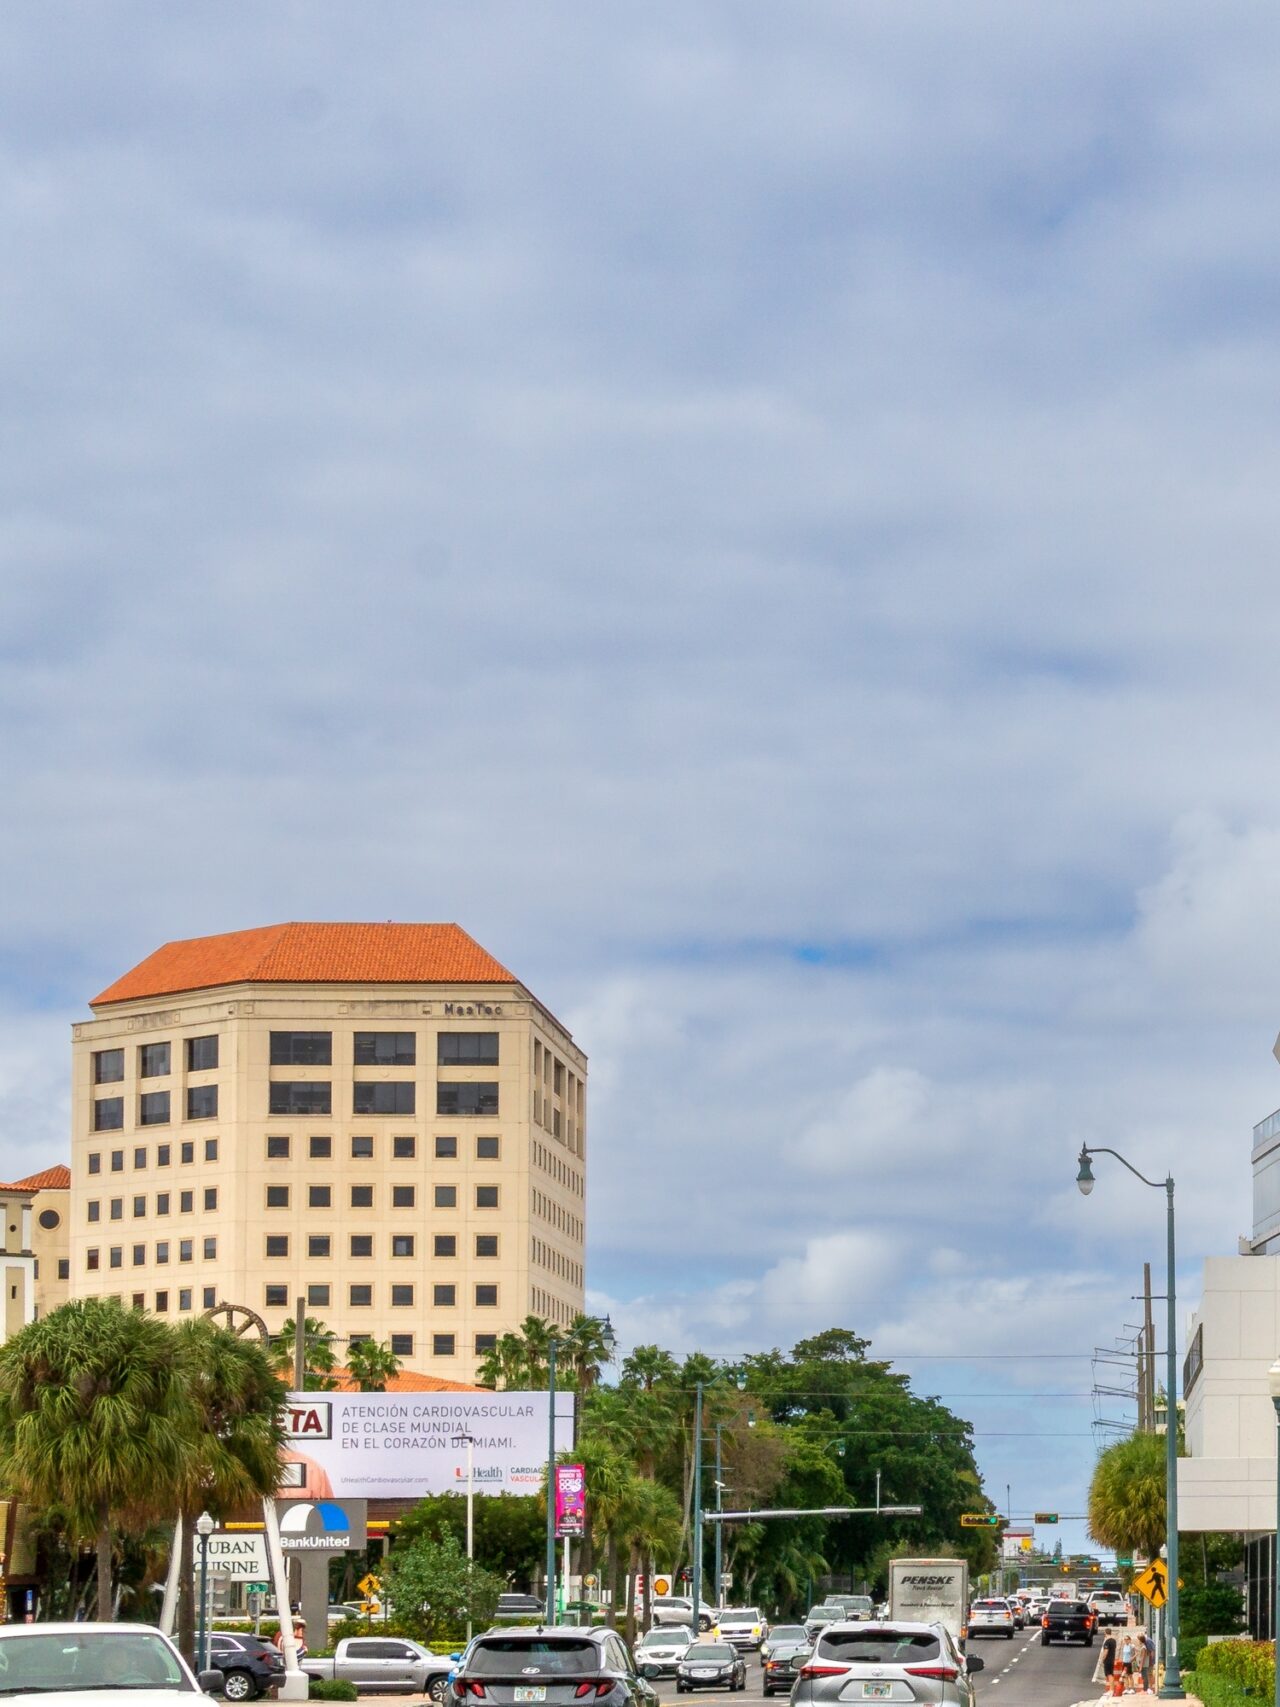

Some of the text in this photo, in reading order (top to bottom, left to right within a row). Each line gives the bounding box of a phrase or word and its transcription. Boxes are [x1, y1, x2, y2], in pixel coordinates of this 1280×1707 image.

[341, 1404, 534, 1418] ATENCIÓN CARDIOVASCULAR
[342, 1422, 472, 1433] DE CLASE MUNDIAL
[342, 1435, 516, 1449] EN EL CORAZÓN DE MIAMI.
[280, 1536, 350, 1548] BankUnited
[900, 1575, 956, 1585] PENSKE
